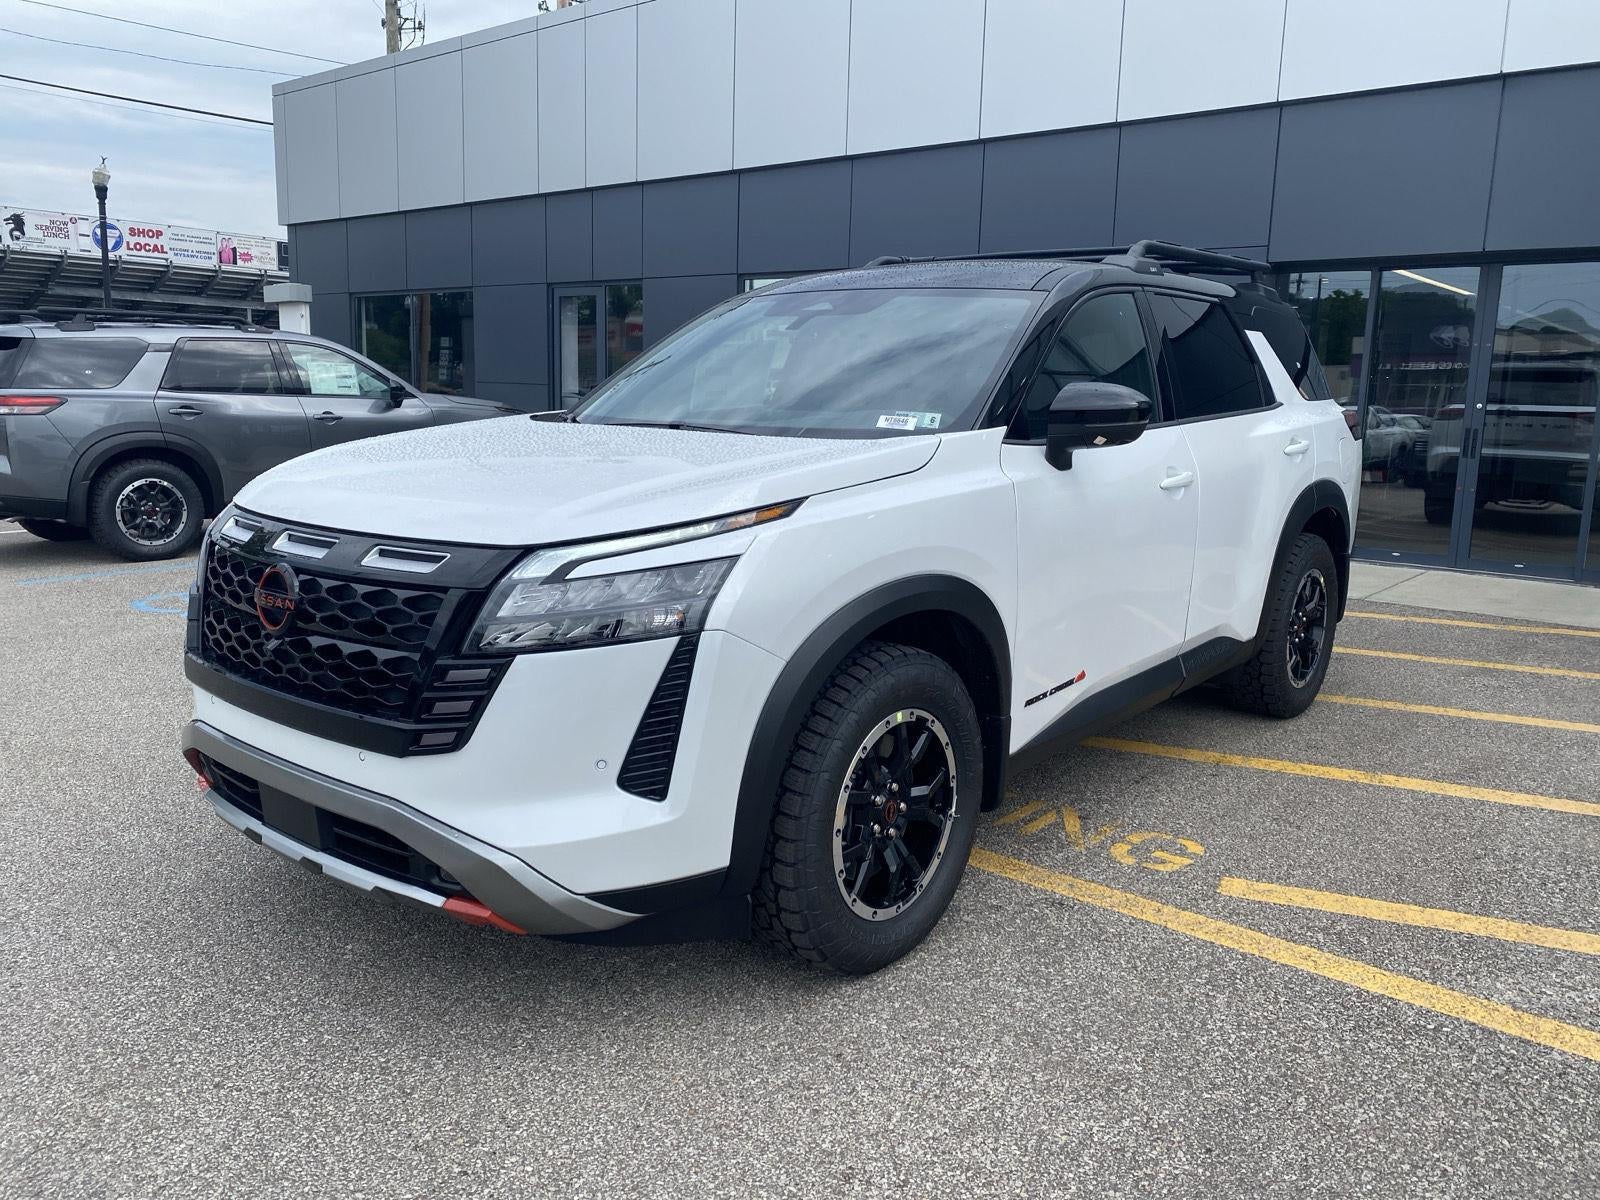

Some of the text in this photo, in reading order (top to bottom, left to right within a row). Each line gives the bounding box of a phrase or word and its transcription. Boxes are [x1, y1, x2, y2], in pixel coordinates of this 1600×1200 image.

[49, 219, 69, 227] NOW
[34, 224, 69, 233] SERVING
[128, 227, 164, 239] SHOP
[42, 231, 70, 240] LUNCH
[126, 241, 168, 254] LOCAL
[930, 416, 936, 424] 6
